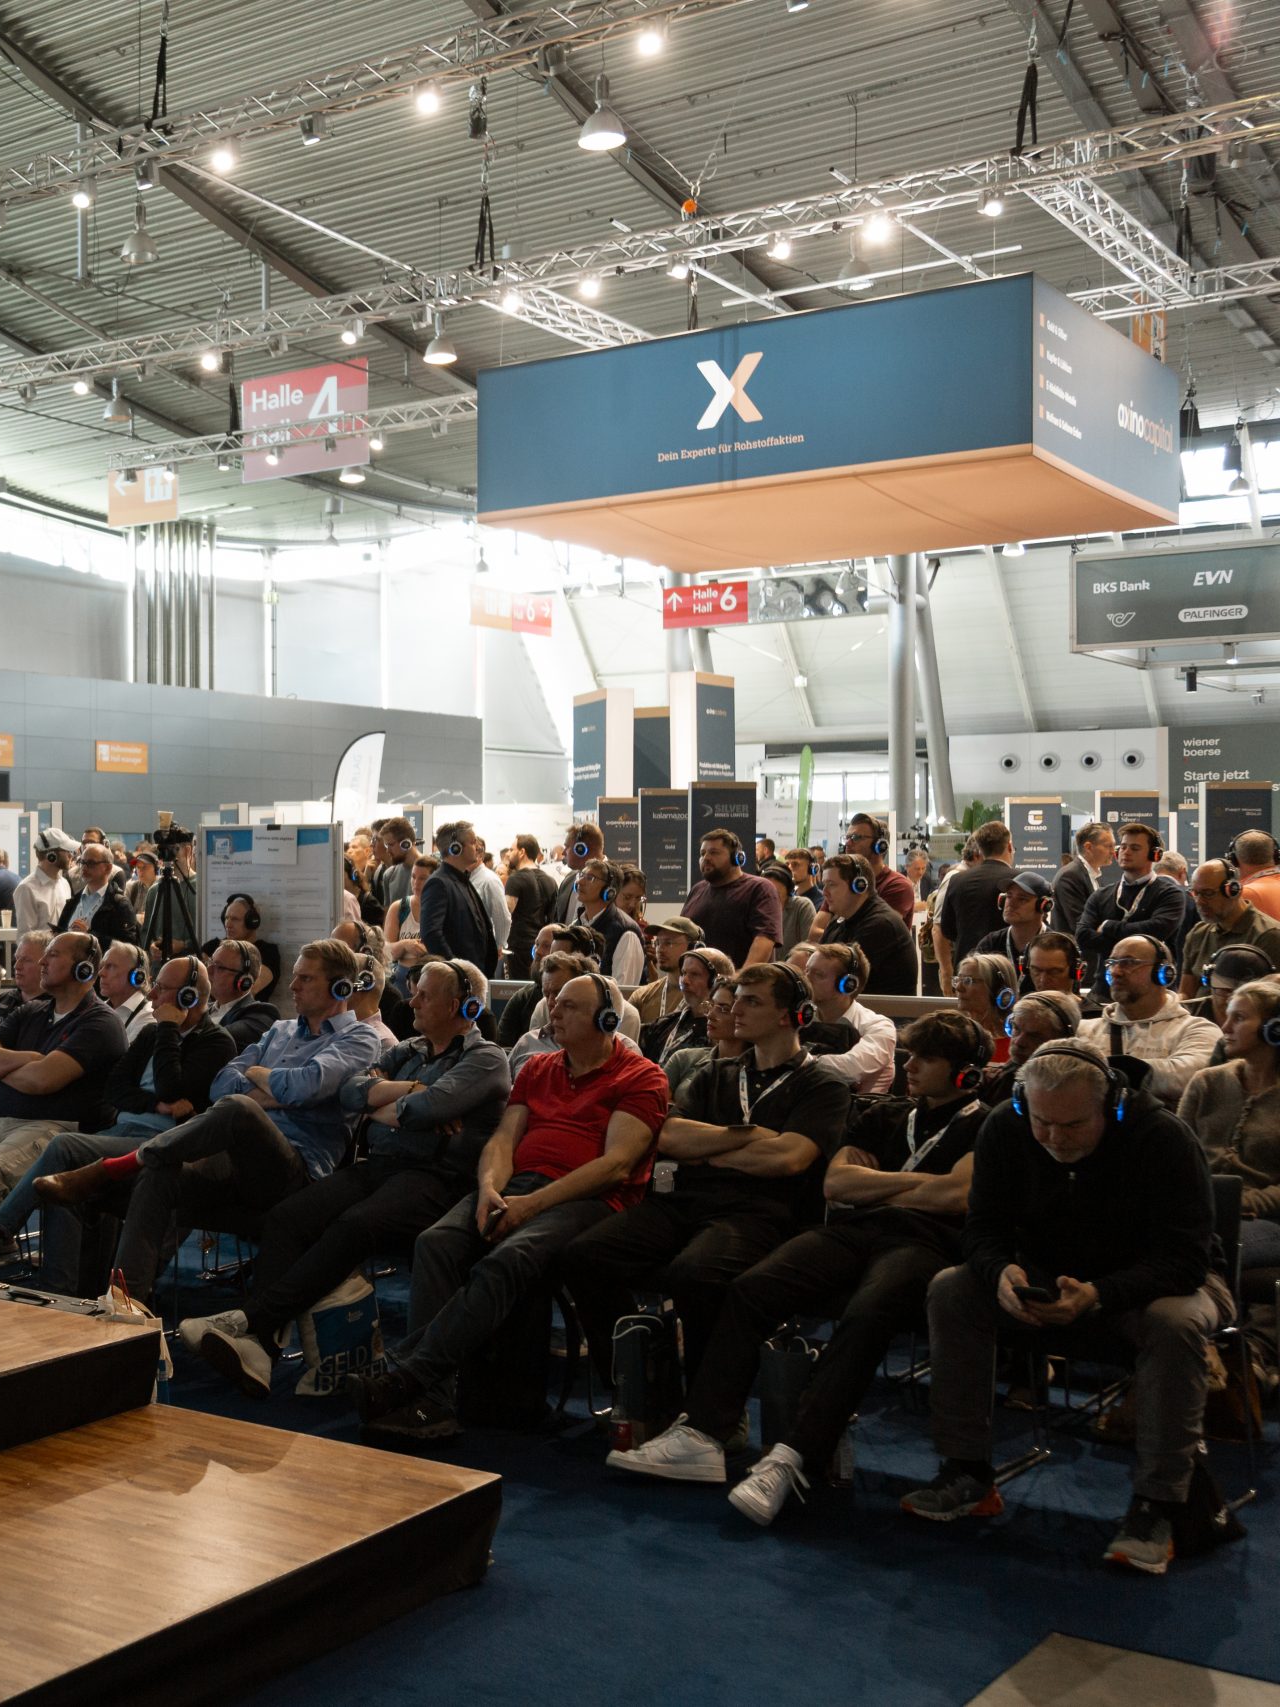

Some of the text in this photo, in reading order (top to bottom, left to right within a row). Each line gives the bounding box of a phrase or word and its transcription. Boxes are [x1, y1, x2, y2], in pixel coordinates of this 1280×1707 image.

[252, 376, 344, 434] Halle 4
[658, 434, 805, 462] Dein Experte für Rohstoffaktien
[1193, 569, 1233, 586] EVN
[1093, 580, 1151, 594] BKS Bank
[692, 586, 737, 612] Halle 6
[692, 603, 712, 614] Hall
[1183, 606, 1243, 620] PALFINGER
[1183, 738, 1220, 747] wiener
[1183, 748, 1221, 757] boerse
[1184, 770, 1250, 782] Starte jetzt
[1184, 784, 1199, 793] mi
[319, 1345, 369, 1375] GELD
